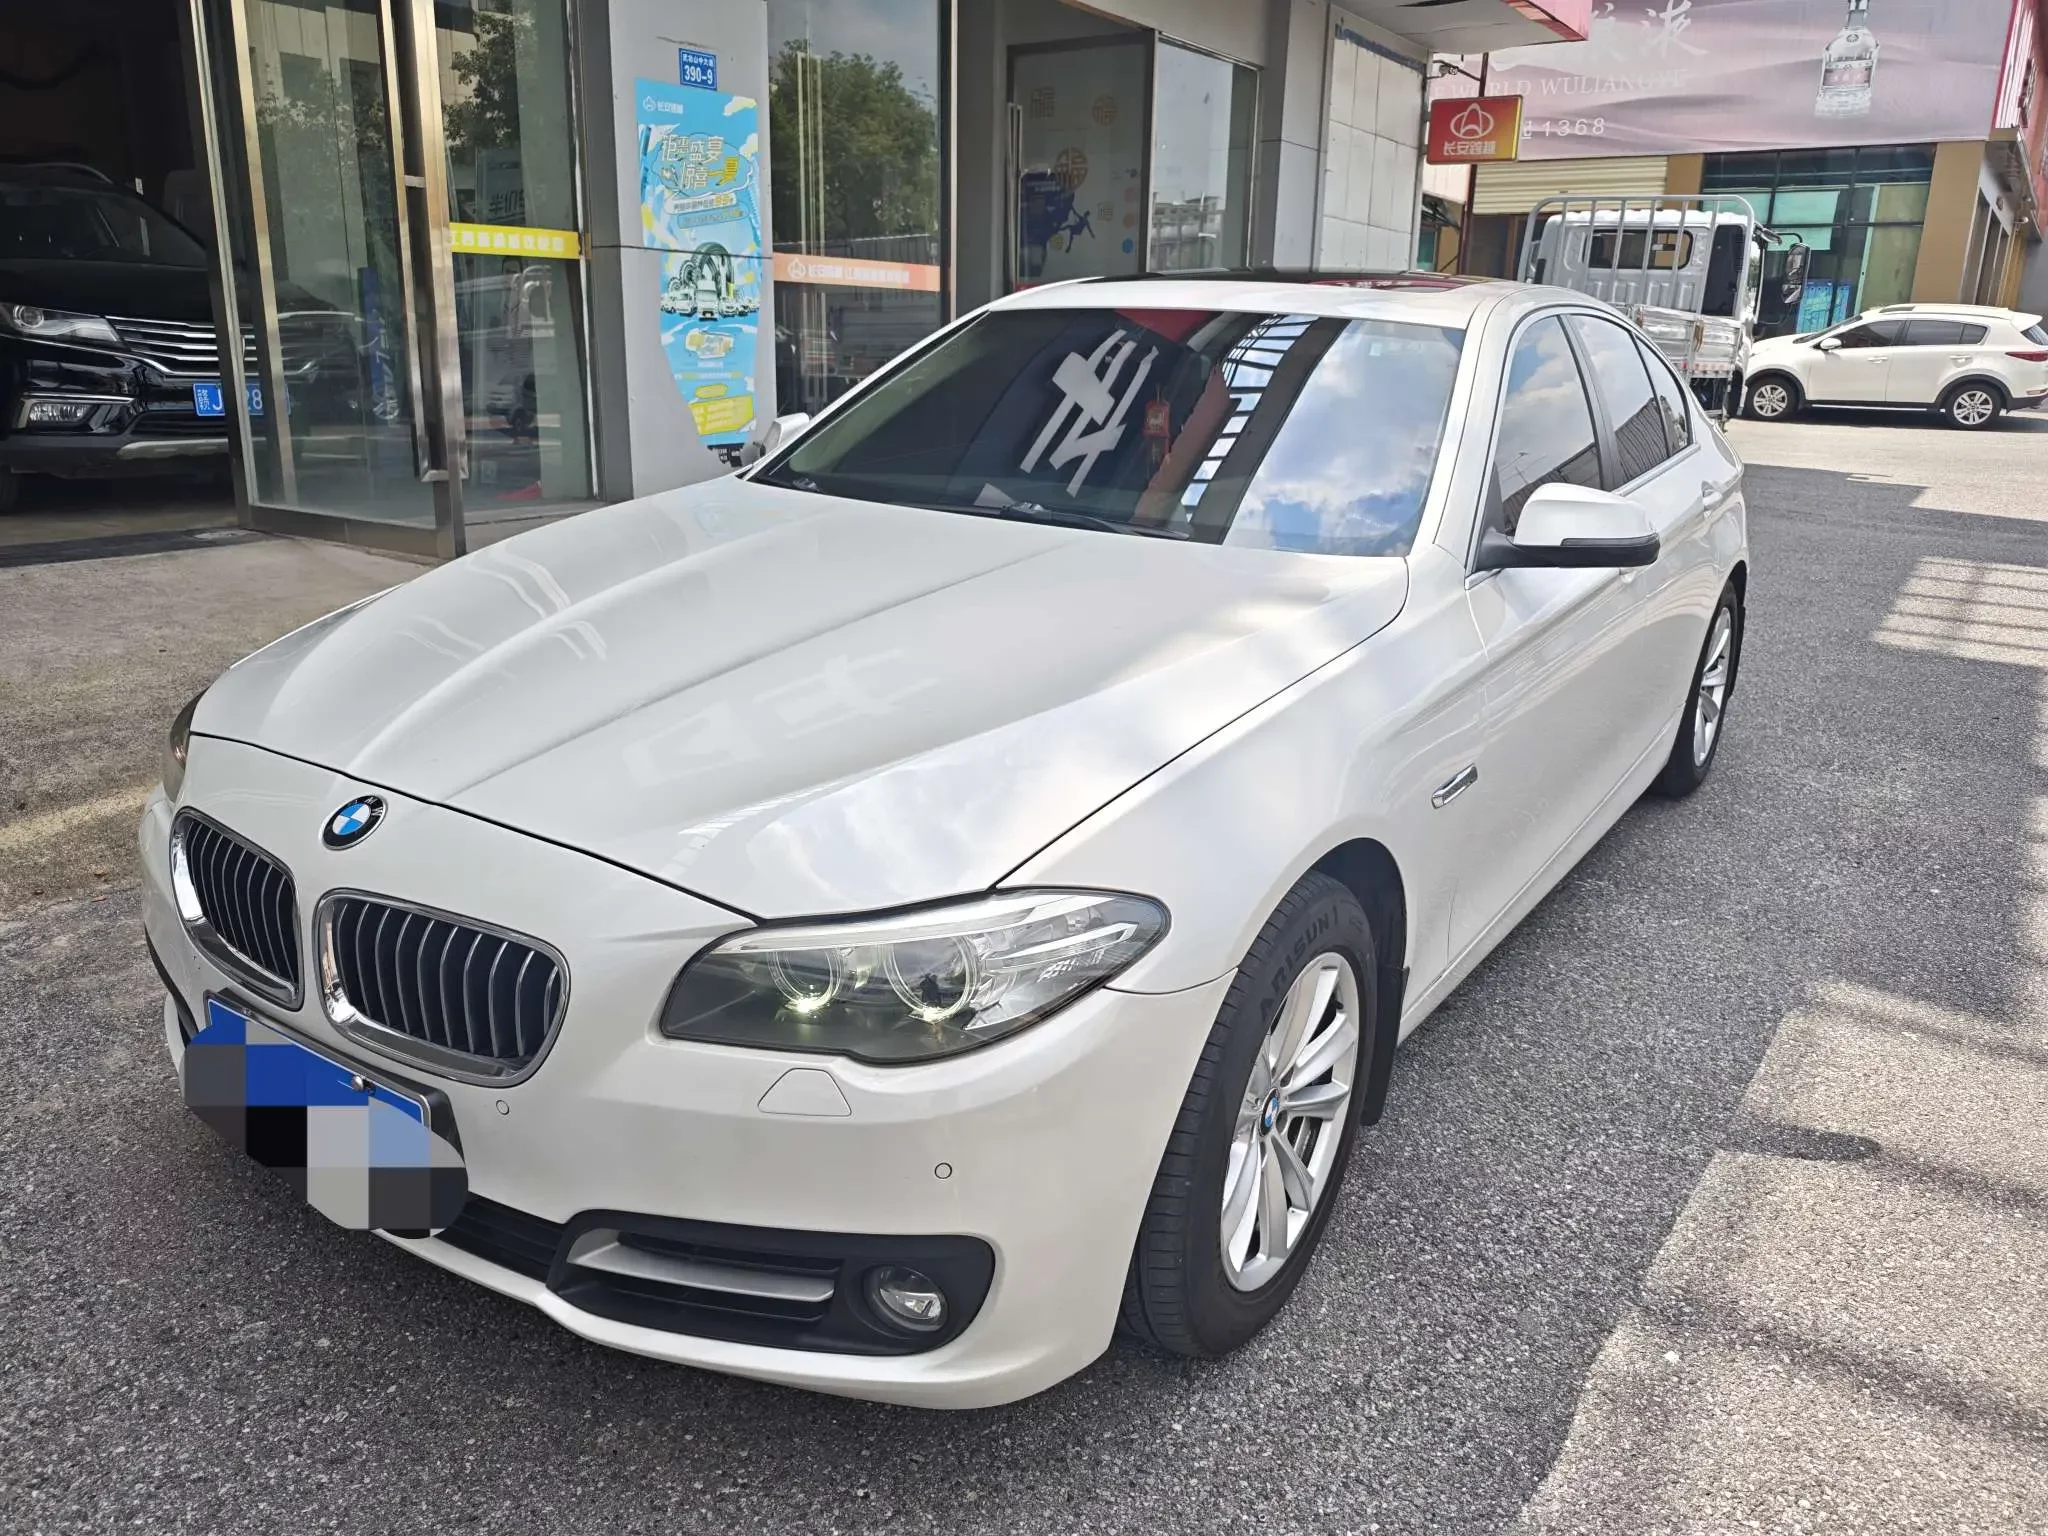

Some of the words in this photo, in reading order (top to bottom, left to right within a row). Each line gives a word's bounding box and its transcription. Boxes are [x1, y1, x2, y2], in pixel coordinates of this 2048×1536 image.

[684, 64, 713, 85] 390-9
[1541, 116, 1605, 137] 1368
[1443, 140, 1497, 156] 长安跨越
[1258, 910, 1331, 1024] ARISUN
